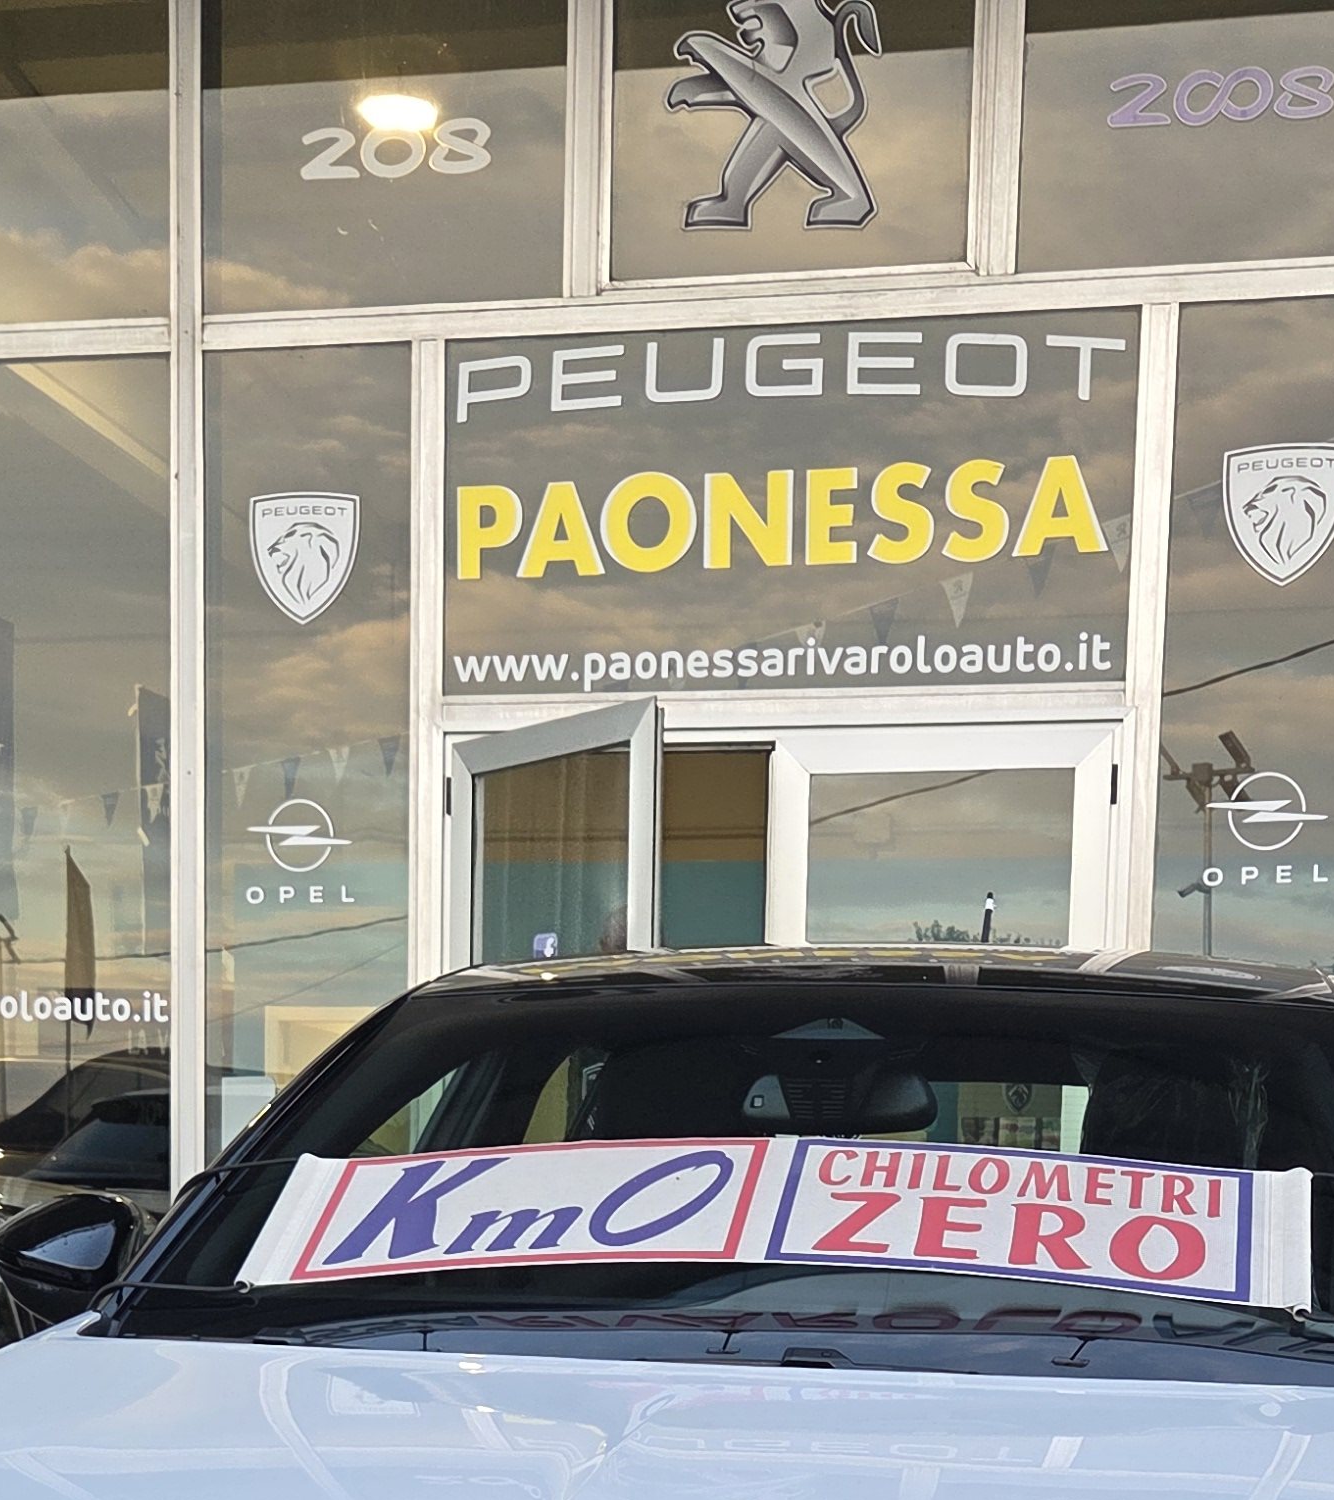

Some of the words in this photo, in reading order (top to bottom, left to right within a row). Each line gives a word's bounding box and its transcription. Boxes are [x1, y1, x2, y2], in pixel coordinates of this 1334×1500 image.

[299, 117, 492, 180] 208
[456, 331, 1127, 424] PEUGEOT
[261, 506, 348, 520] PEUGEOT
[456, 454, 1109, 580] PAONESSA
[453, 632, 1112, 691] www.paonessarivaroloauto.it
[245, 885, 356, 905] OPEL
[1202, 863, 1329, 887] OPEL
[817, 1148, 1223, 1218] CHILOMETRI
[810, 1190, 1208, 1282] ZERO
